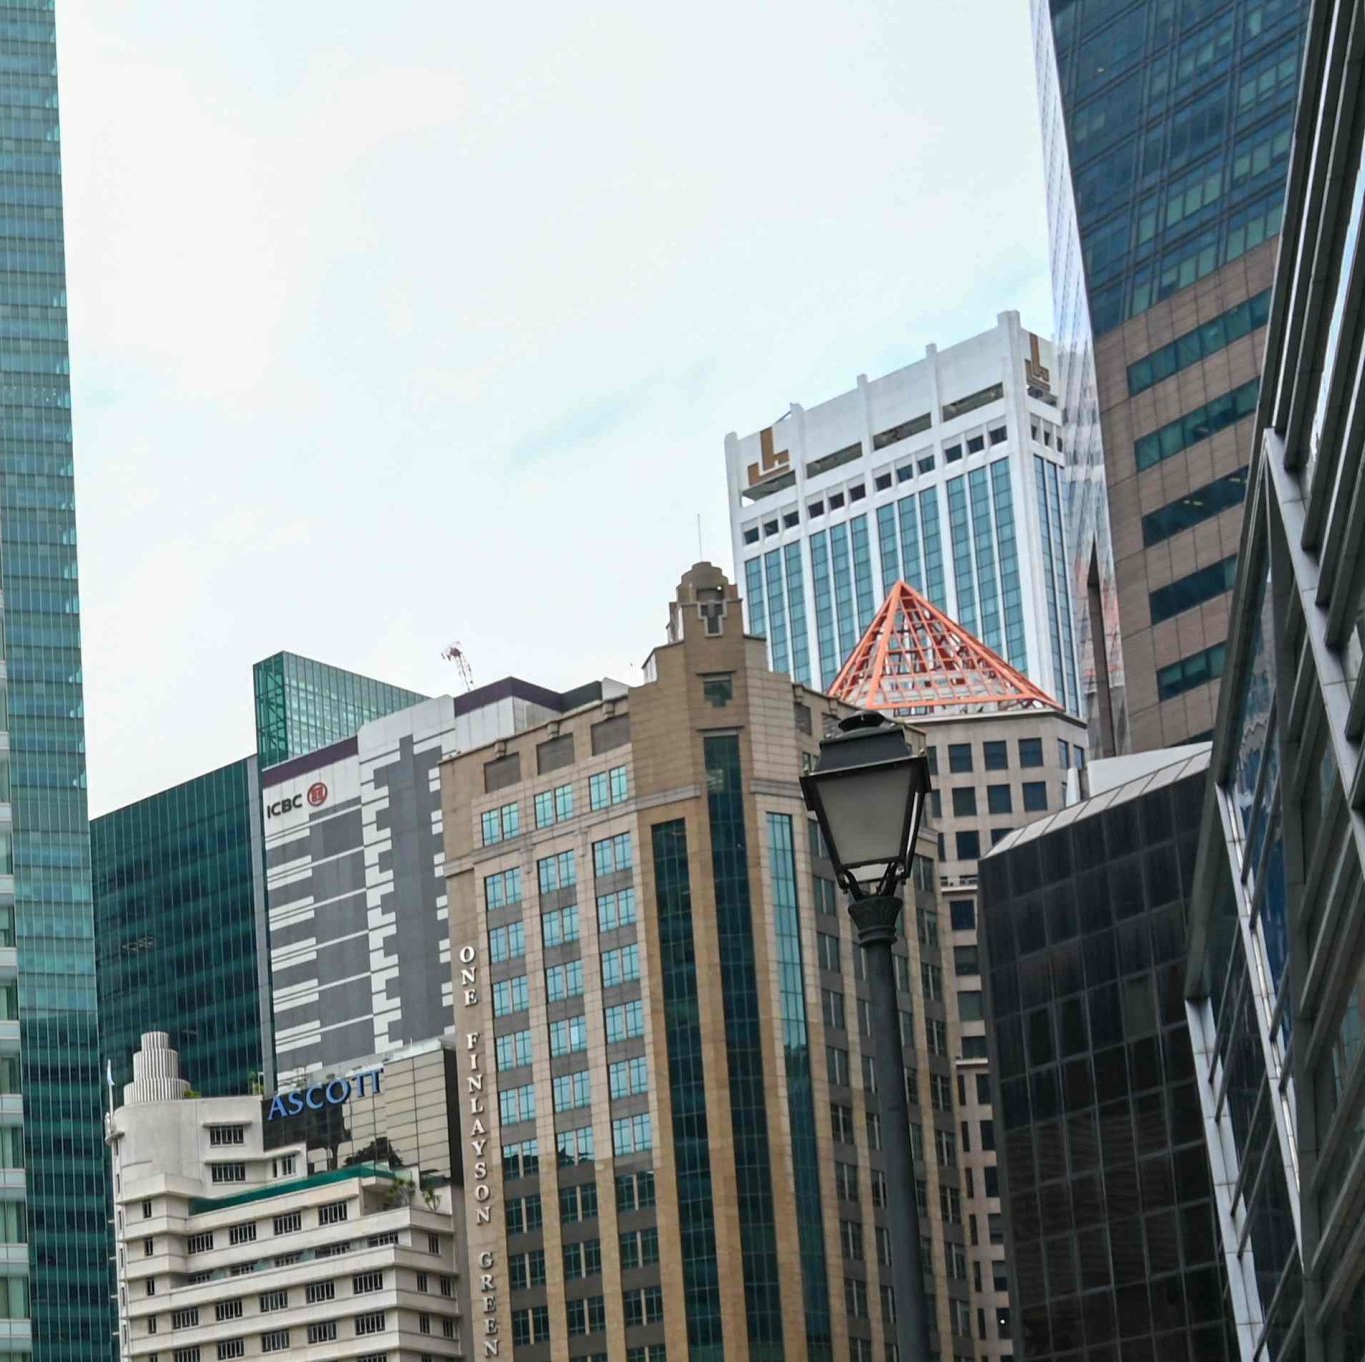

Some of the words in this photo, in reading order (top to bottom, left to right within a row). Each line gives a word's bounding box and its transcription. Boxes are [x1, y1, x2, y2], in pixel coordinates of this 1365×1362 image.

[267, 794, 302, 818] ICBC
[459, 946, 478, 1006] ONE
[268, 1068, 384, 1121] ASCOTT
[466, 1032, 492, 1225] FINLAYSON
[478, 1251, 499, 1358] GREEN
